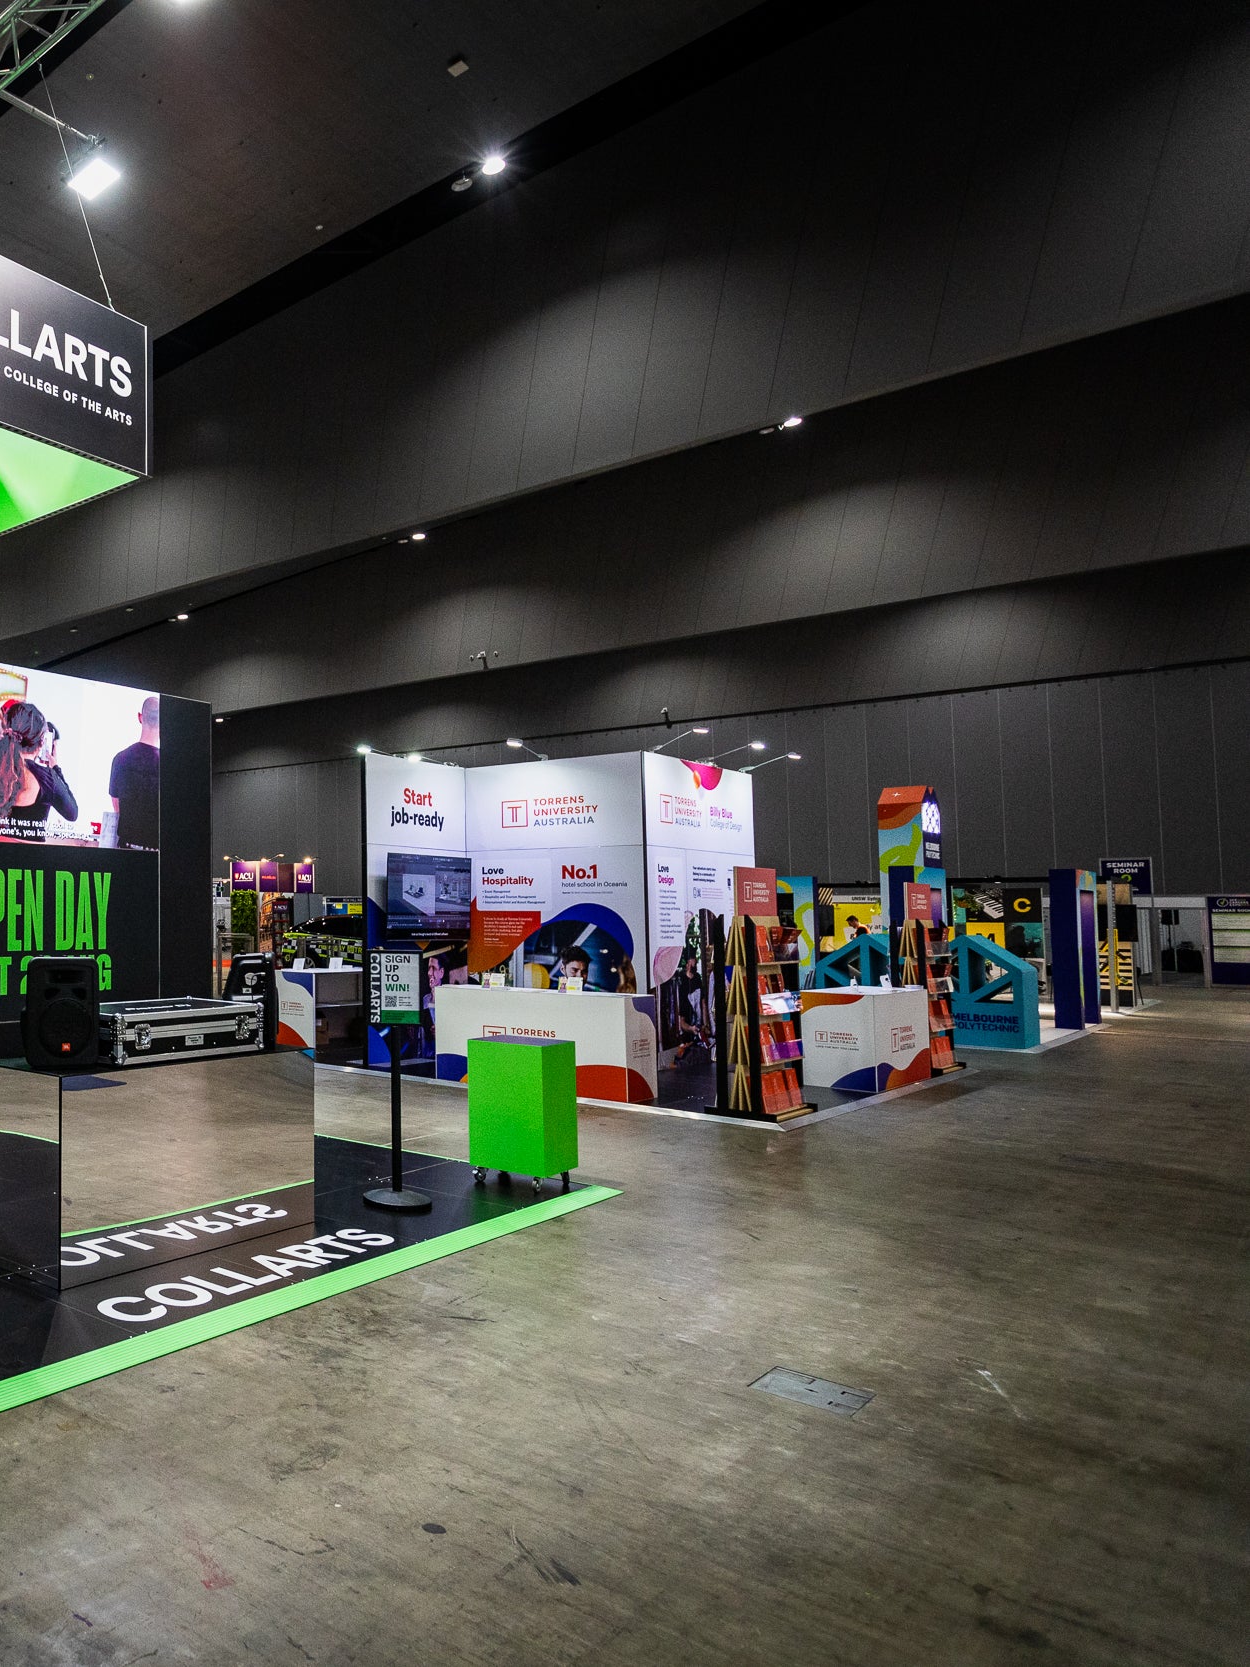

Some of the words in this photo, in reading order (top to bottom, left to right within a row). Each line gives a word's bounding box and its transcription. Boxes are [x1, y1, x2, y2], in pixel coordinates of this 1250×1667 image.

[4, 366, 59, 400] COLLEGE
[63, 388, 78, 404] OF
[81, 396, 102, 415] THE
[105, 406, 133, 426] ARTS
[404, 788, 432, 807] Start
[534, 795, 585, 806] TORRENS
[675, 796, 697, 808] TORRENS
[534, 804, 599, 816] UNIVERSITY
[675, 807, 702, 817] UNIVERSITY
[710, 806, 721, 819] Billy
[722, 808, 733, 819] Blue
[391, 806, 444, 832] job-ready
[534, 816, 595, 827] AUSTRALIA
[675, 818, 701, 828] AUSTRALIA
[23, 829, 35, 837] you
[37, 828, 56, 838] know,
[482, 867, 504, 875] Love
[561, 864, 598, 880] No.1
[658, 864, 669, 873] Love
[482, 876, 534, 887] Hospitality
[658, 875, 674, 886] Design
[56, 870, 112, 951] DAY
[1013, 898, 1032, 913] C
[385, 955, 410, 963] SIGN
[385, 965, 399, 973] UP
[385, 974, 399, 982] TO
[385, 984, 410, 992] WIN!
[953, 1013, 1019, 1025] MELBOURNE
[511, 1027, 556, 1038] TORRENS
[97, 1228, 395, 1322] COLLARTS
